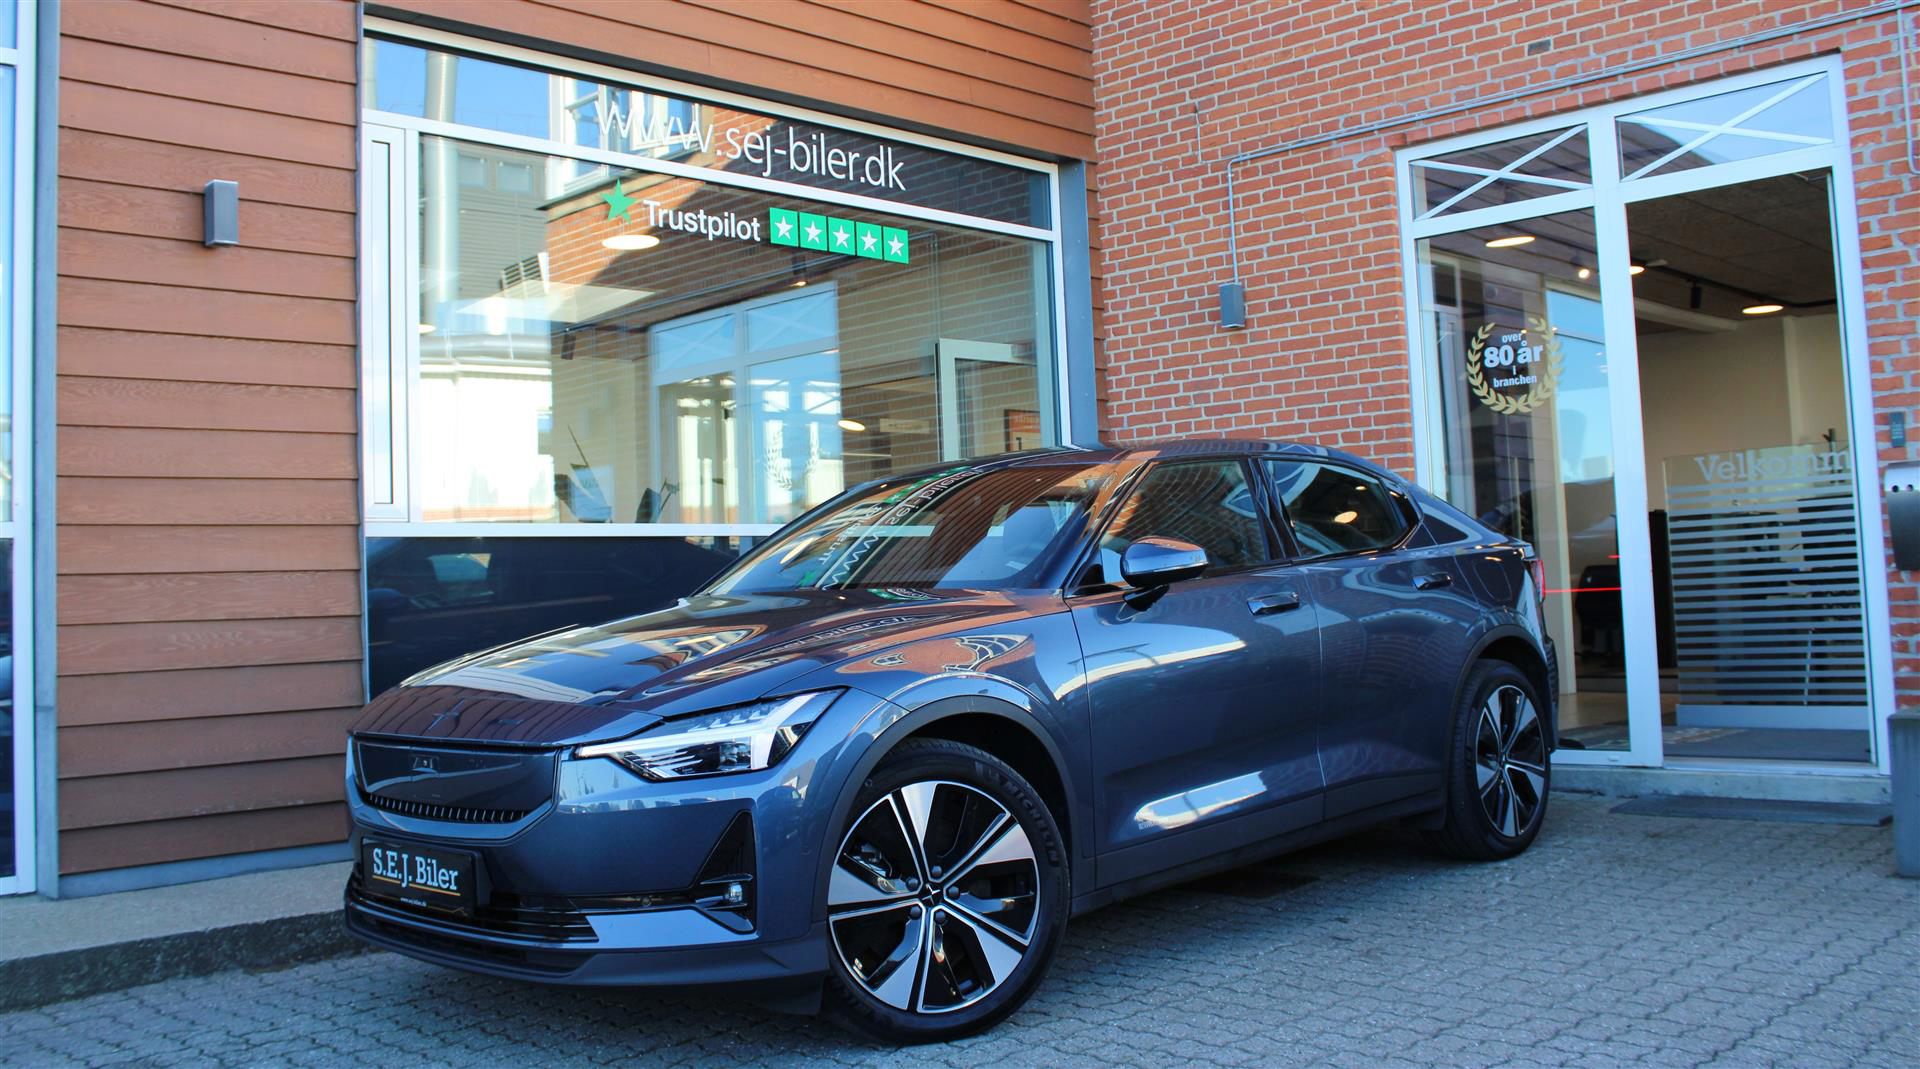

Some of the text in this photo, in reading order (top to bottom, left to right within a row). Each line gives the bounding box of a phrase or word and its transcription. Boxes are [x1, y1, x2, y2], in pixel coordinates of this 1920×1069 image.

[595, 101, 906, 191] www.sej-biler.dk
[643, 200, 761, 241] Trustpilot
[1484, 340, 1543, 368] 80 år
[1502, 333, 1523, 343] over
[1493, 375, 1537, 387] branchen
[1004, 782, 1059, 863] MICHELIN
[373, 848, 459, 890] S.E.J. Biler
